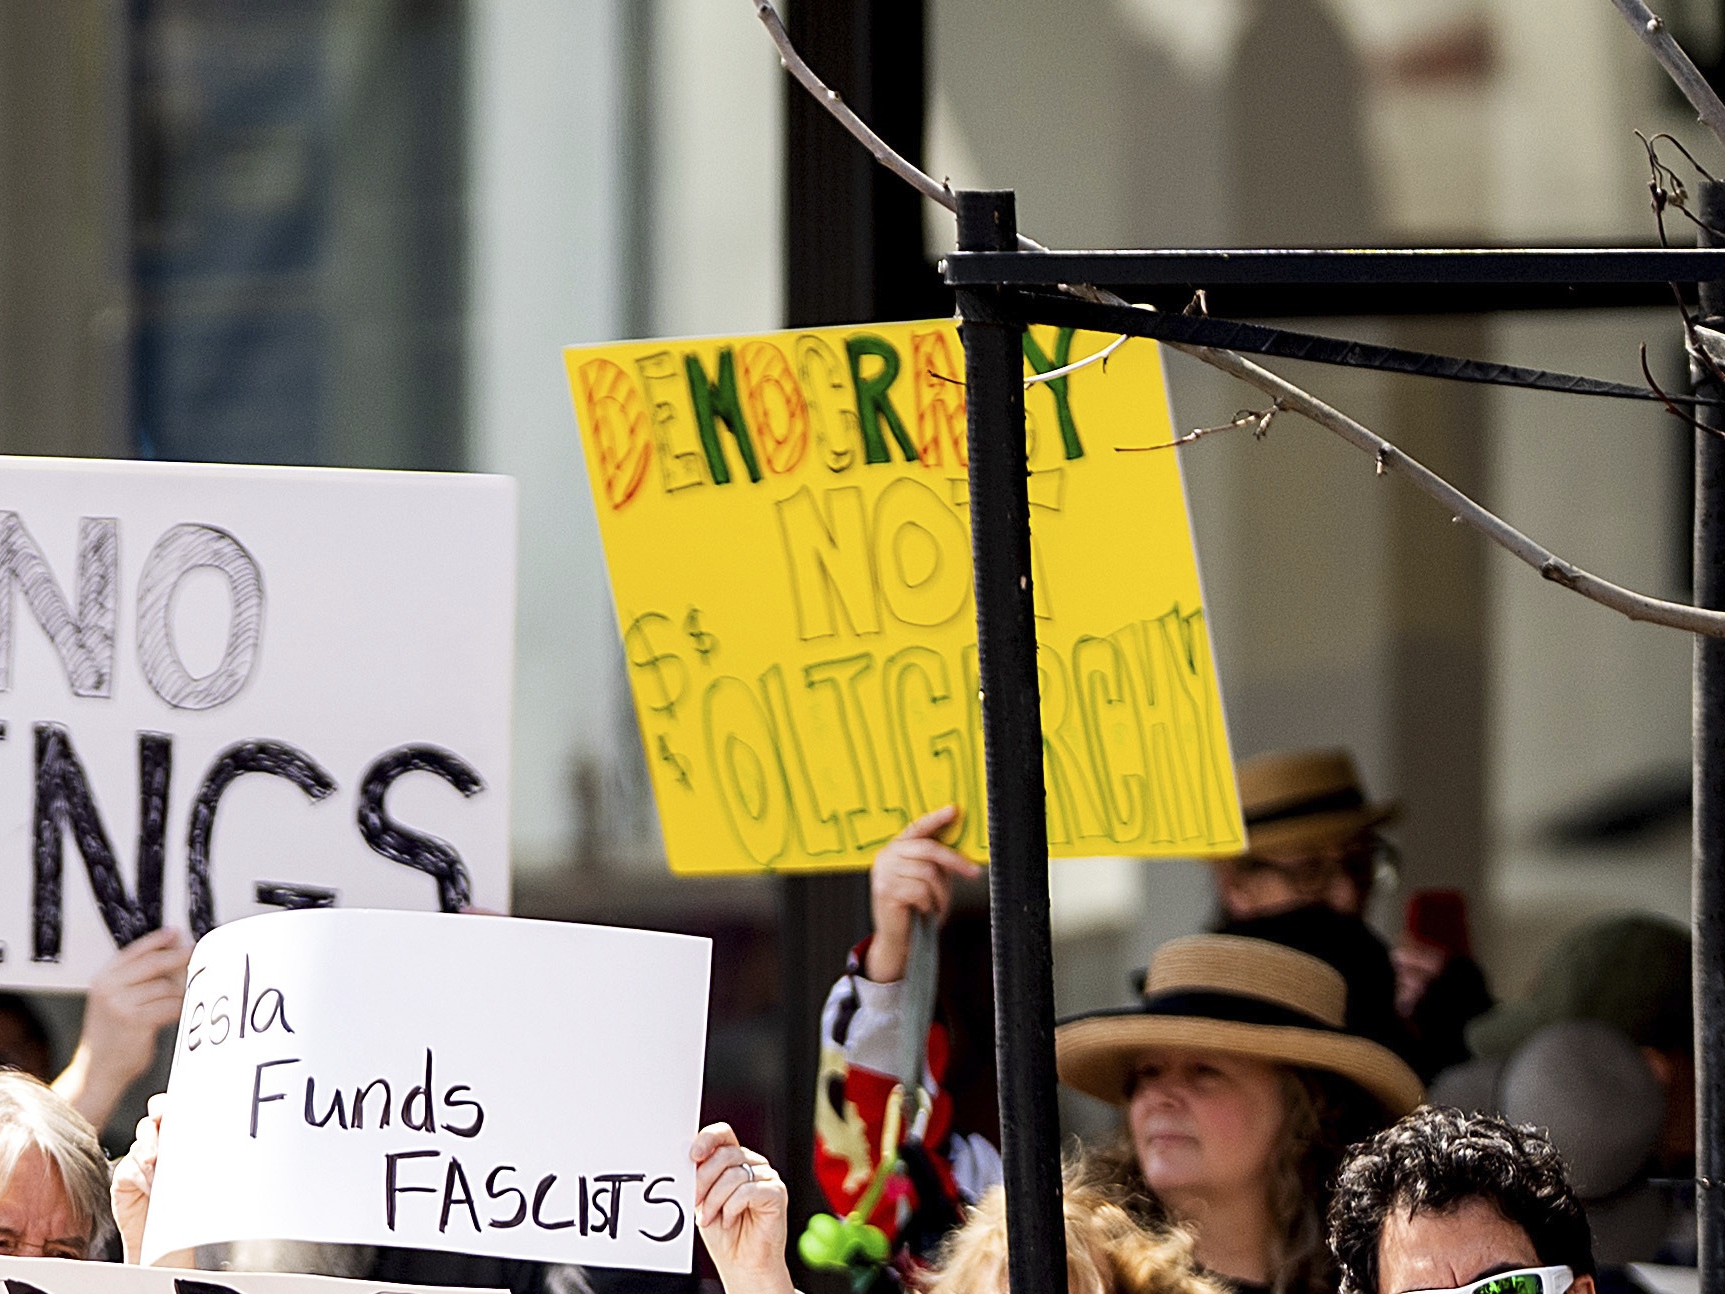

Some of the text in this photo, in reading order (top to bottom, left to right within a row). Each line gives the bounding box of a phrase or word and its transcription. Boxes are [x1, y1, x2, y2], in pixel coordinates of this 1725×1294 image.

[579, 327, 1085, 511] DEMOCRAY
[701, 604, 1241, 871] OLIGRCHY
[251, 1048, 485, 1139] Funds
[385, 1150, 685, 1243] FASCISTS
